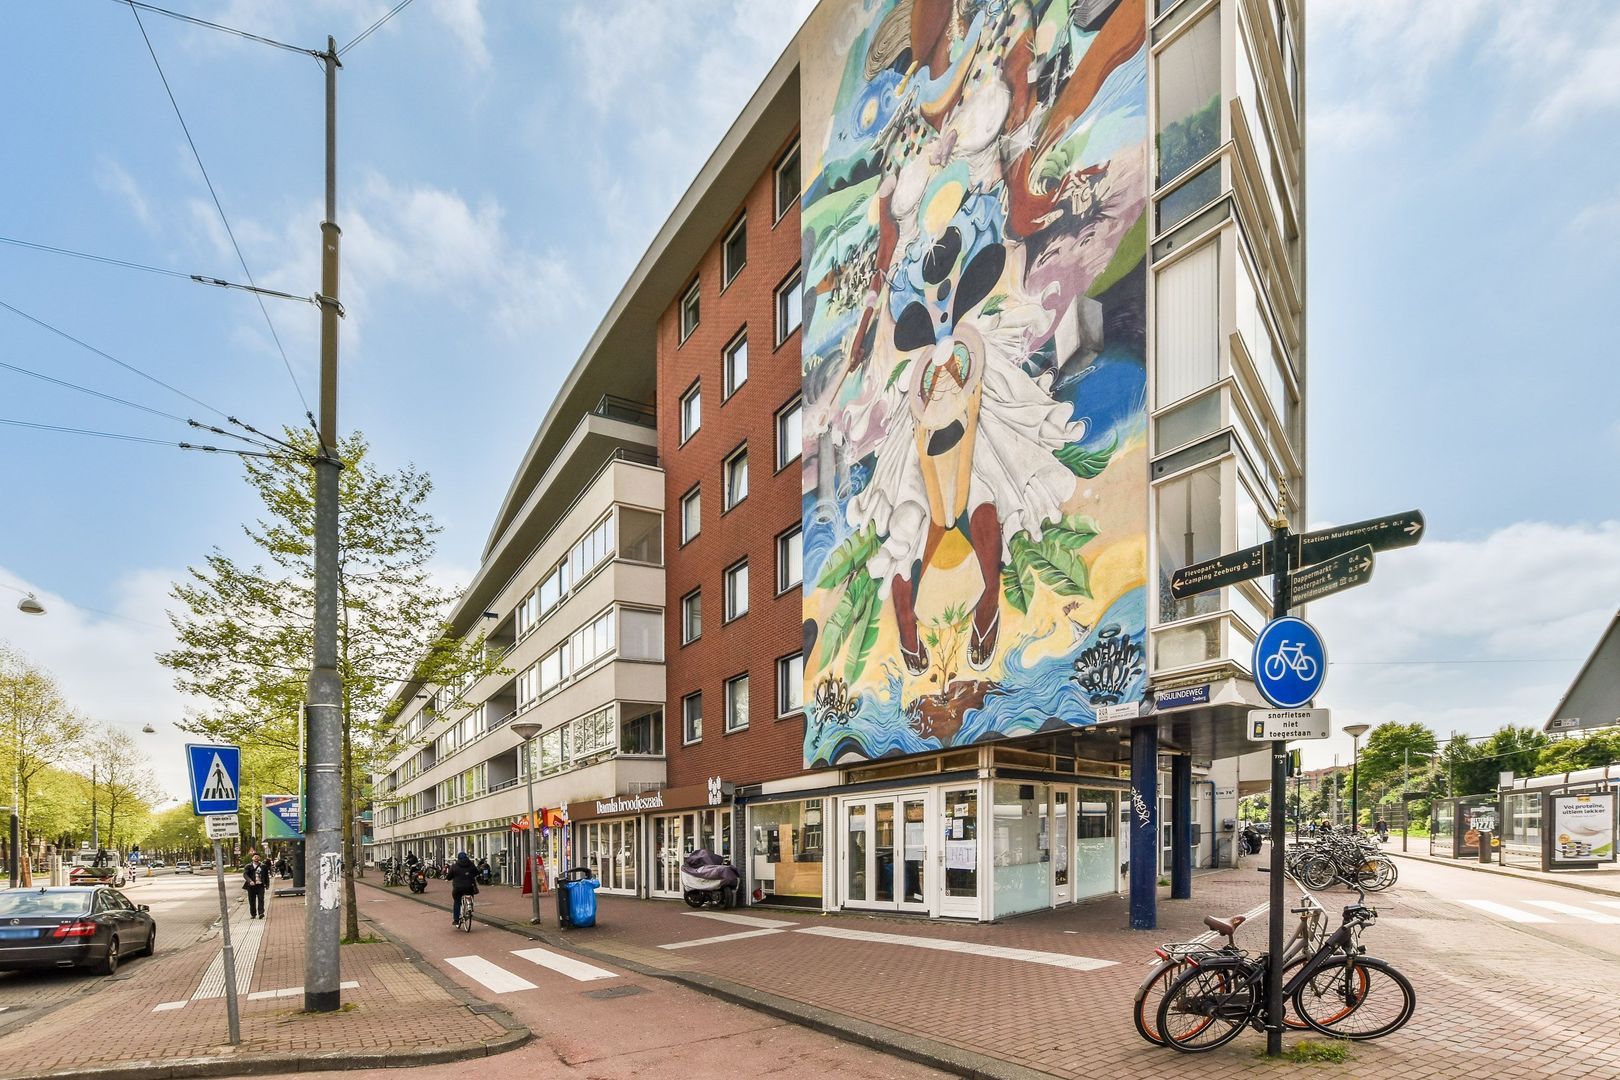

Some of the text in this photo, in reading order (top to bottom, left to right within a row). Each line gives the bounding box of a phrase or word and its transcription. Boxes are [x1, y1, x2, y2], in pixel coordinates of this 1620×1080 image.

[1303, 535, 1330, 545] Station
[1331, 525, 1378, 539] Muiderpoort
[1184, 564, 1216, 578] Flevopark
[1184, 573, 1212, 586] Camping
[1213, 565, 1241, 577] Zeeburg
[1293, 565, 1332, 585] Dappermarkt
[1293, 577, 1326, 594] Oosterpark
[1293, 582, 1338, 602] Wereldmuseum
[1159, 688, 1203, 701] INSULINDEWEG
[1270, 731, 1312, 739] toegestaan
[618, 791, 664, 814] broodjeszaak
[1470, 822, 1495, 830] PIZZA
